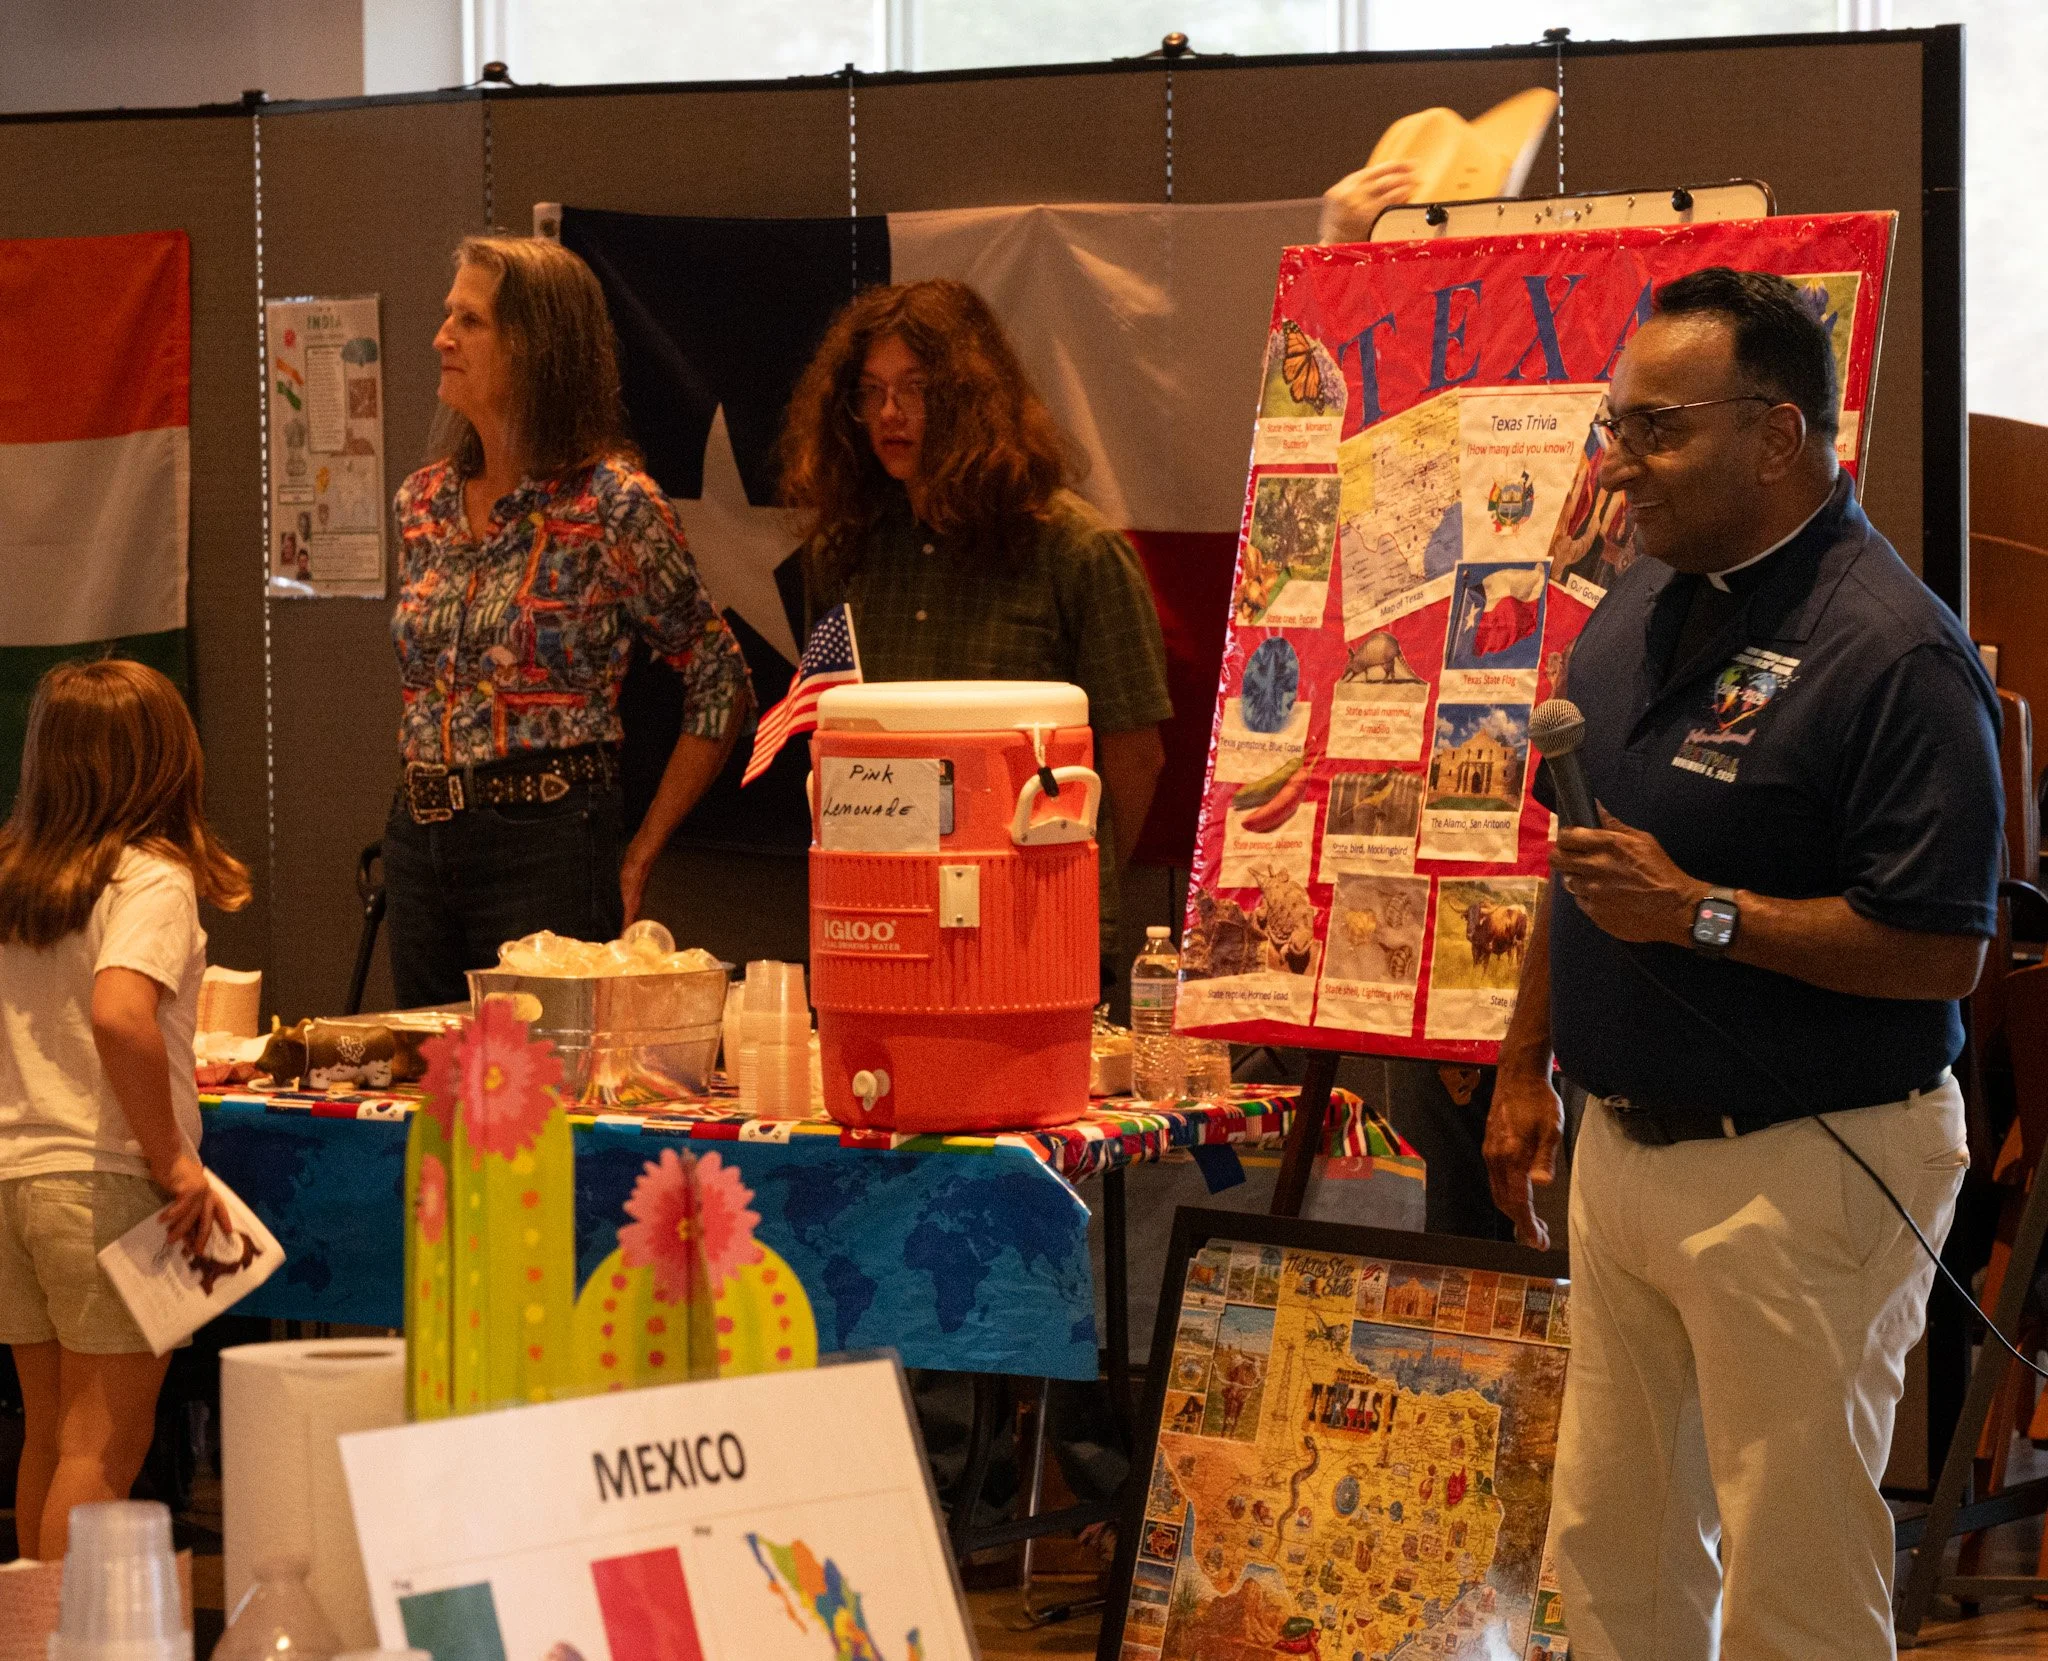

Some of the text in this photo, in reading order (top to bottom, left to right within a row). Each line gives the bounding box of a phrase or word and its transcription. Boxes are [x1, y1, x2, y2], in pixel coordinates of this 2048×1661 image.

[1491, 414, 1557, 431] Texas Trivia
[1467, 441, 1574, 457] (How many did you know?)
[1380, 604, 1396, 617] Map
[1405, 591, 1424, 605] Texas
[1463, 674, 1516, 687] Texas State Flag
[1431, 818, 1511, 831] The Alamo, San Antonio
[1367, 844, 1409, 857] Mockingbird
[824, 919, 895, 941] IGLOO
[1490, 995, 1508, 1008] State
[593, 1431, 746, 1501] MEXICO
